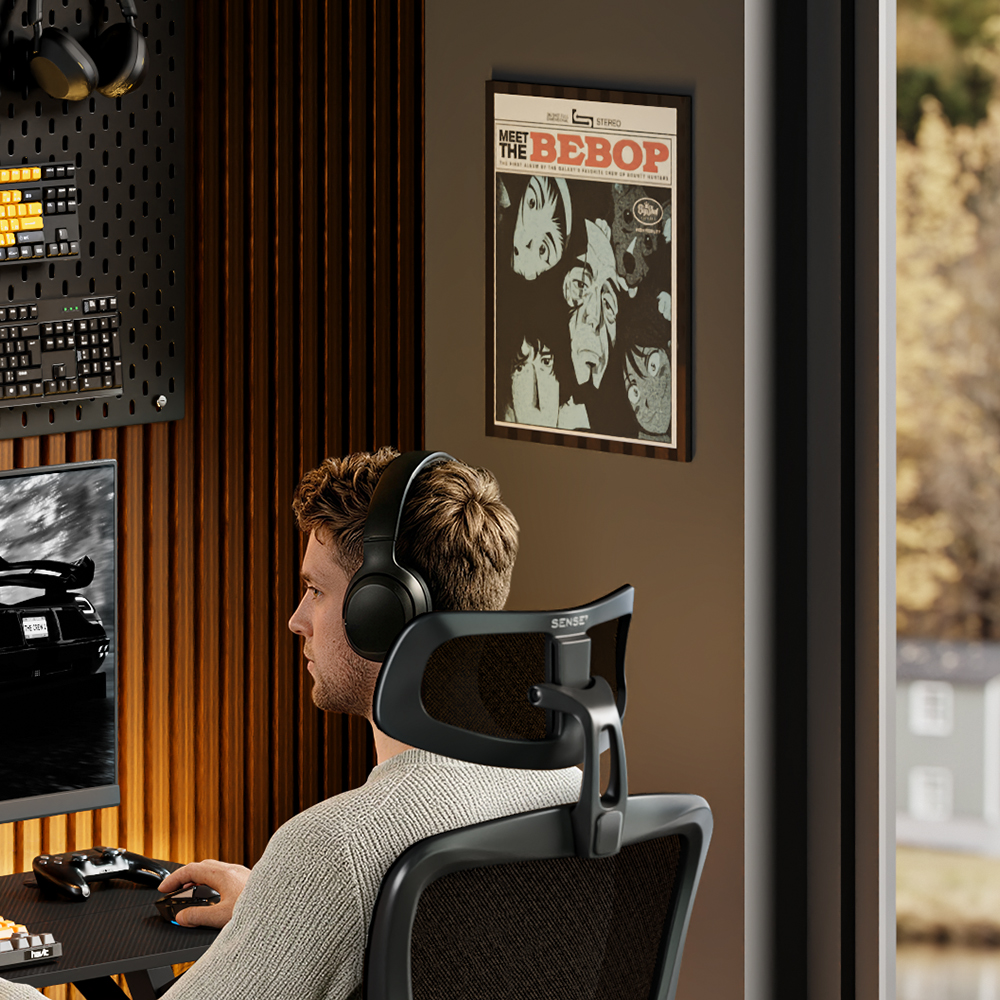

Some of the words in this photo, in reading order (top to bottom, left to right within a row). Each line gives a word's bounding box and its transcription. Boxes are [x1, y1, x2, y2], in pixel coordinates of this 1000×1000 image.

[596, 117, 622, 127] STEREO
[499, 129, 529, 144] MEET
[499, 142, 527, 160] THE
[529, 131, 669, 174] BEBOP
